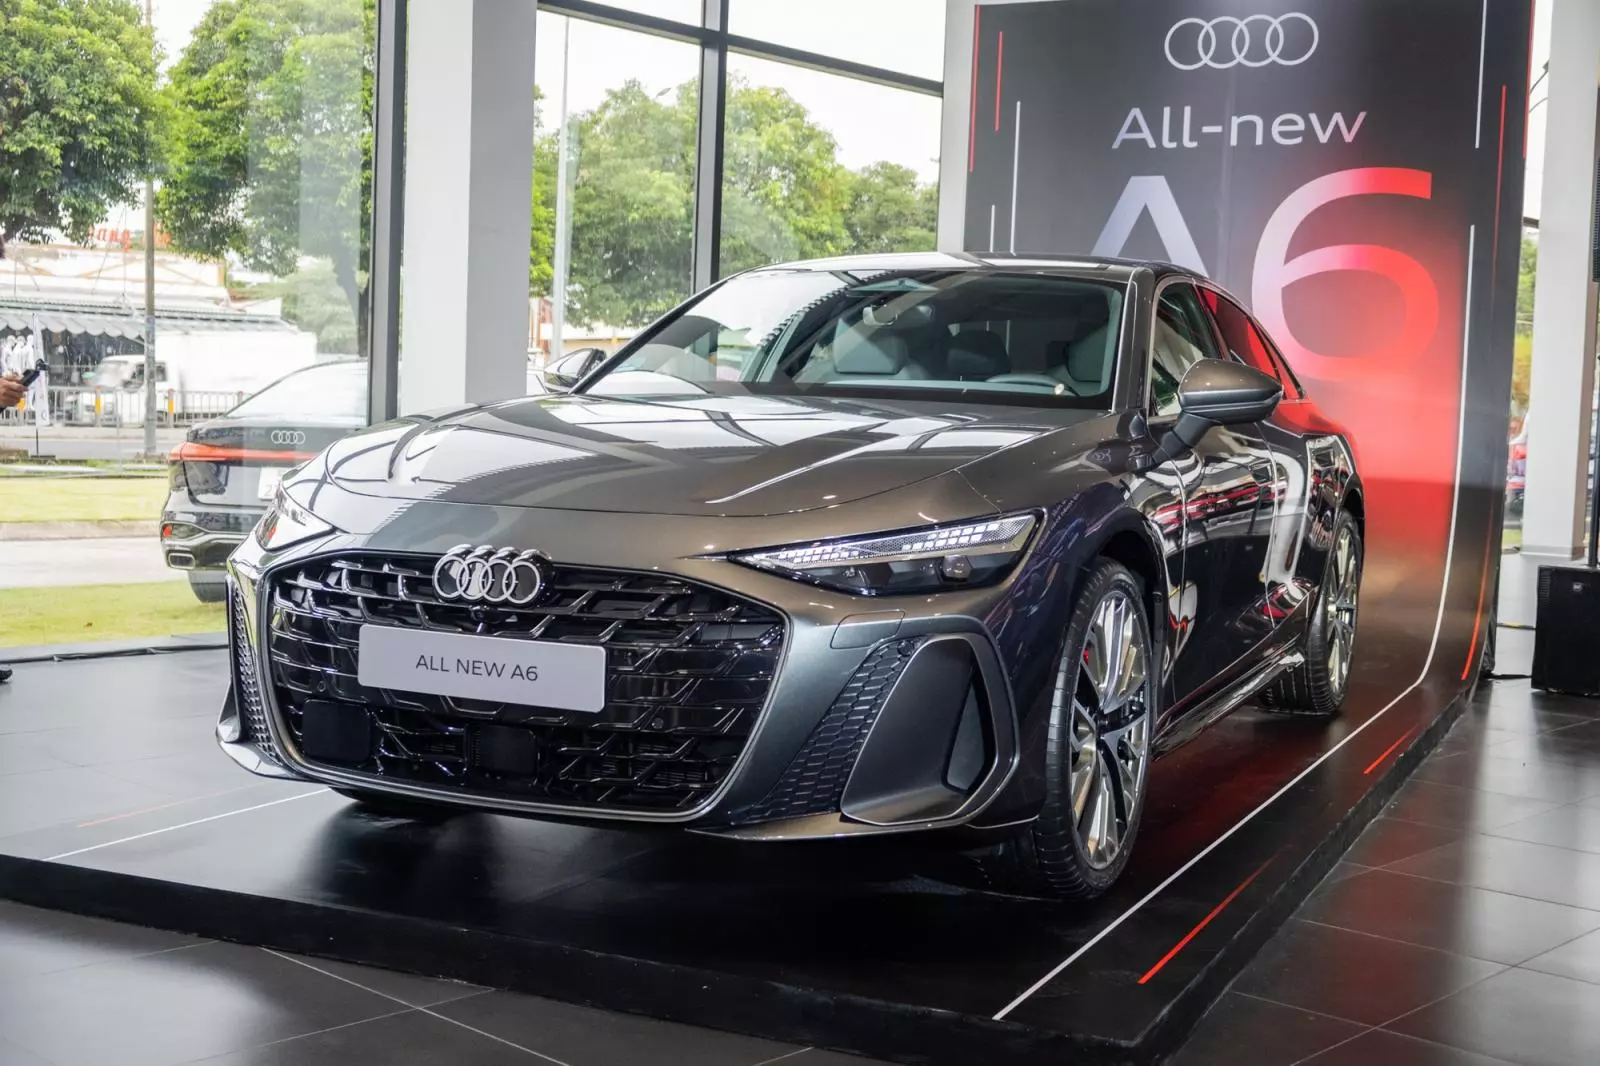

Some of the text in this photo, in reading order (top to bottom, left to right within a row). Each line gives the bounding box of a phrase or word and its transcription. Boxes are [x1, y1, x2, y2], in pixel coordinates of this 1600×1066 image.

[1112, 105, 1367, 149] All-new
[415, 654, 539, 682] ALL NEW A6
